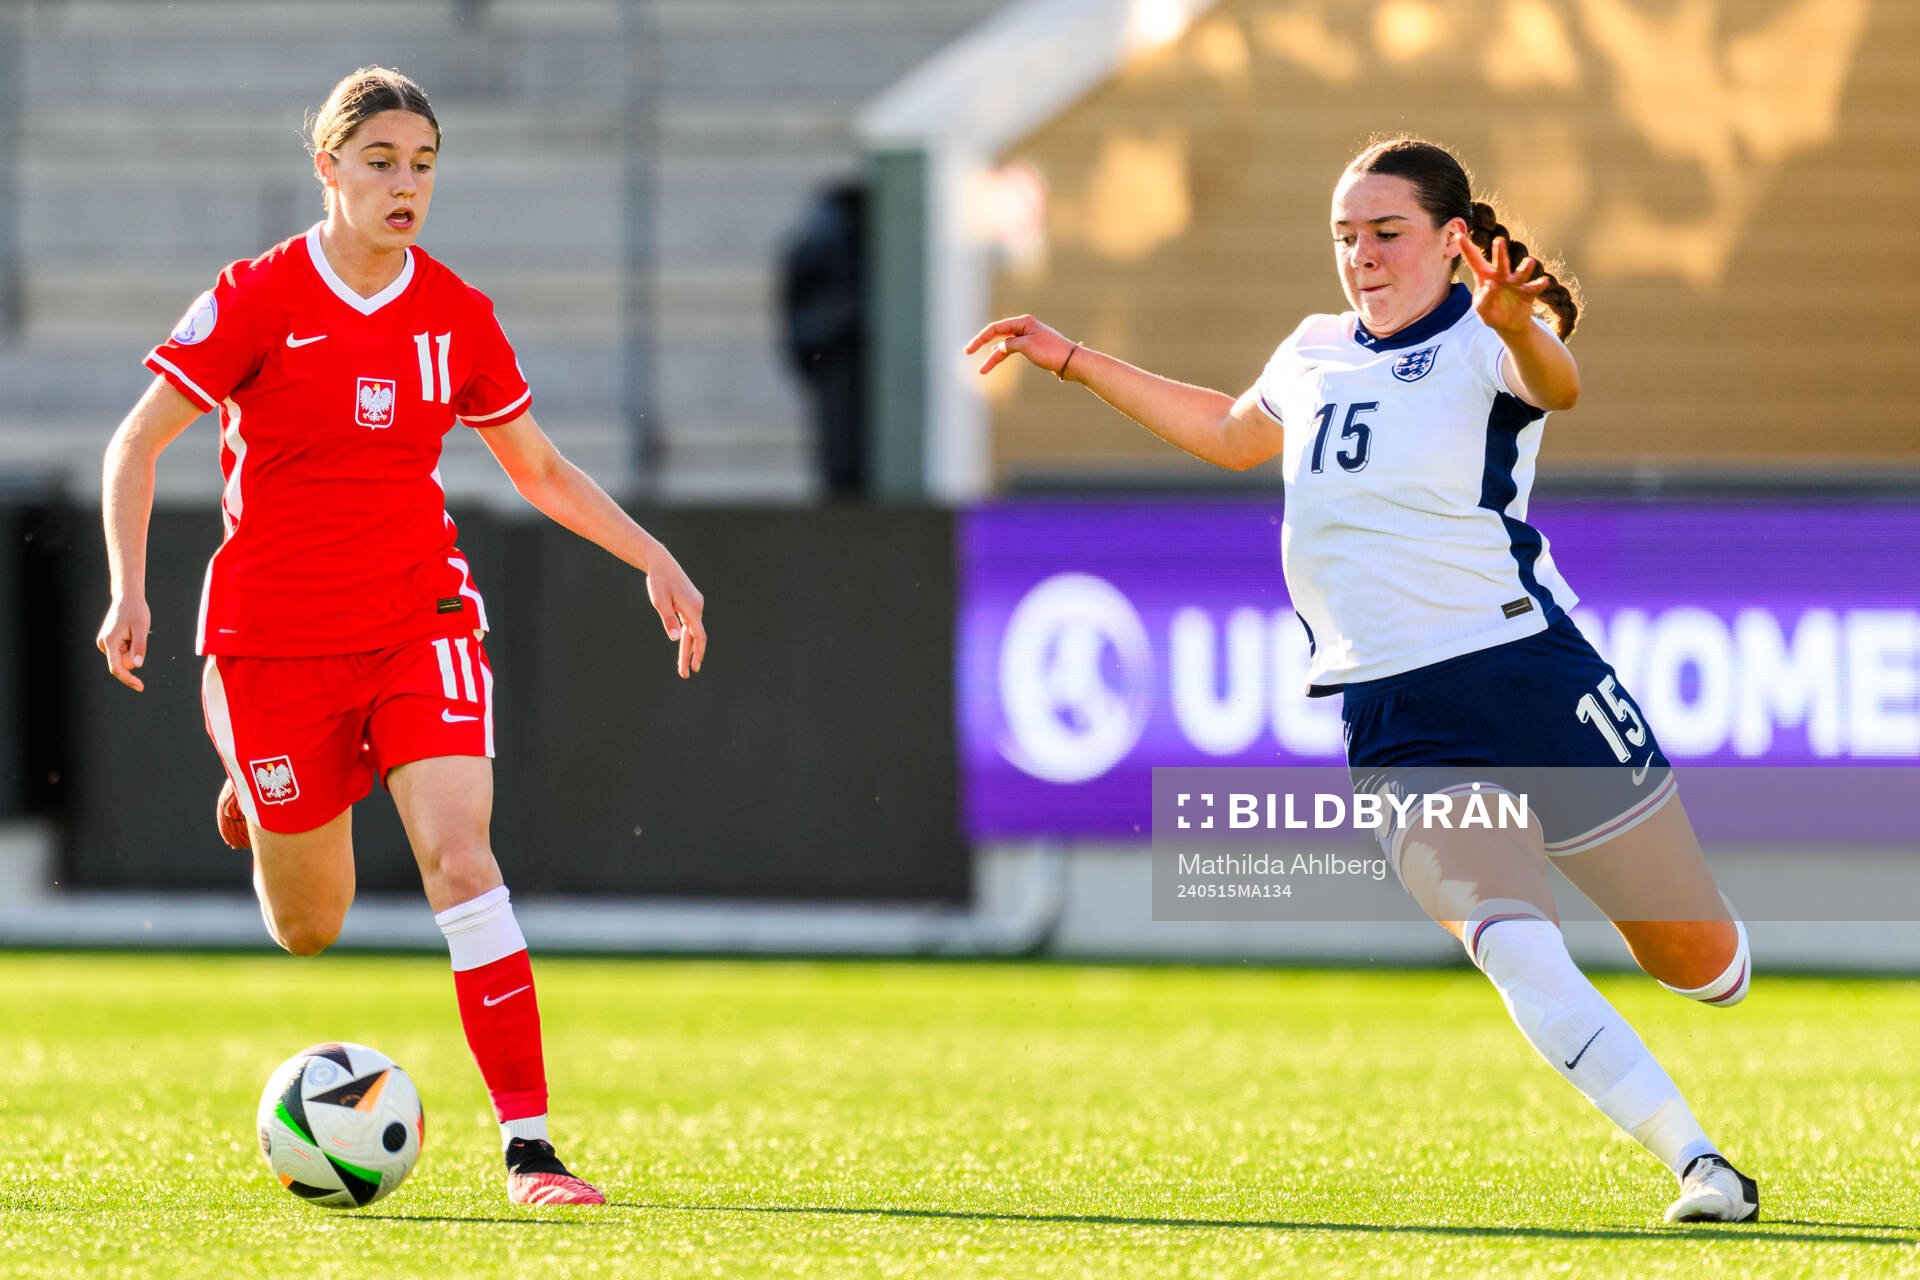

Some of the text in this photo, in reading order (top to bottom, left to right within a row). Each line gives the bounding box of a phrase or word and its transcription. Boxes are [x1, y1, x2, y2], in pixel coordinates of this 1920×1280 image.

[413, 331, 452, 404] 11
[1310, 401, 1381, 474] 15
[431, 637, 479, 703] 11
[1575, 674, 1646, 763] 15
